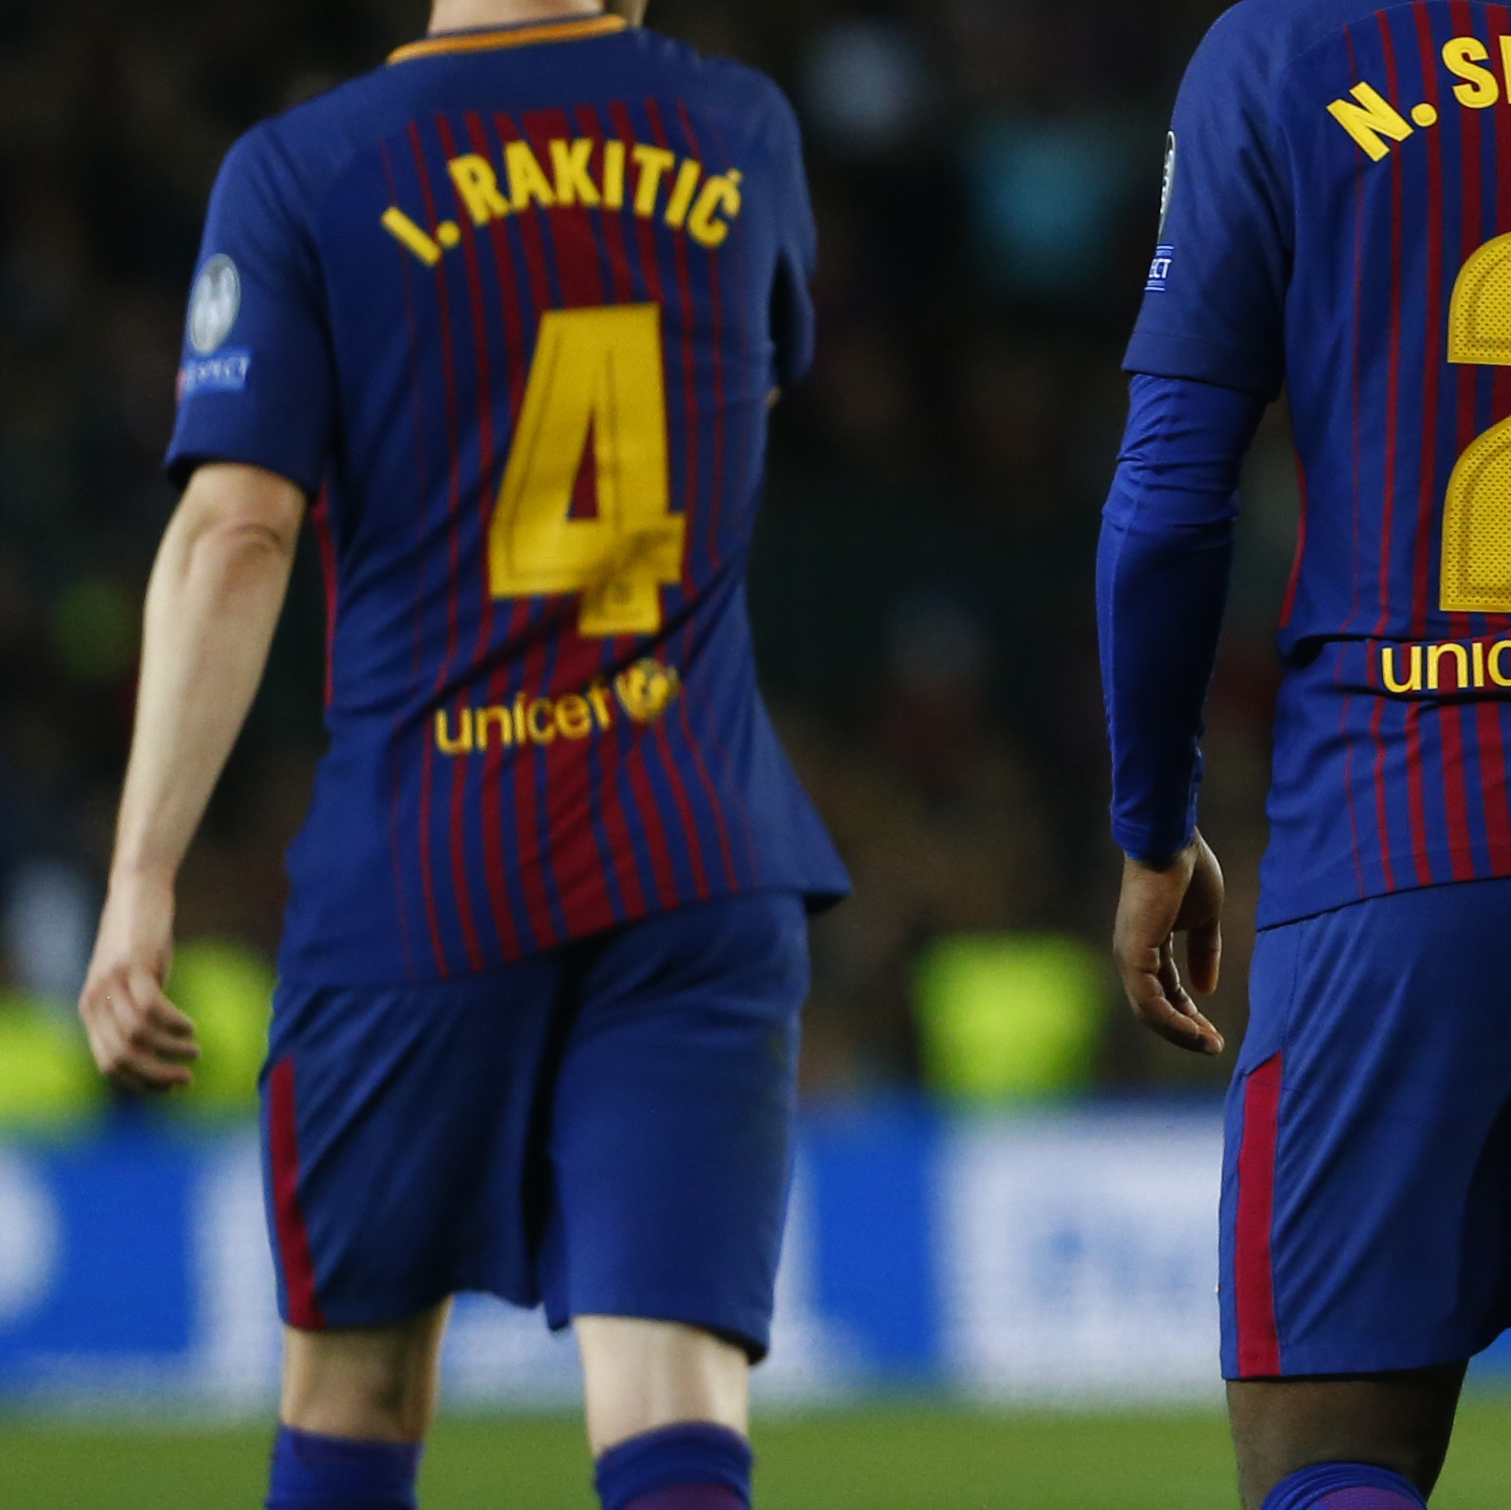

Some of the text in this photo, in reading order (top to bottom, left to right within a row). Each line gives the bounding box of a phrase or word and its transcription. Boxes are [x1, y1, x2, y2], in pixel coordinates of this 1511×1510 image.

[1327, 81, 1438, 161] N.
[380, 136, 743, 267] I. RAKITIĆ
[488, 303, 686, 638] 4
